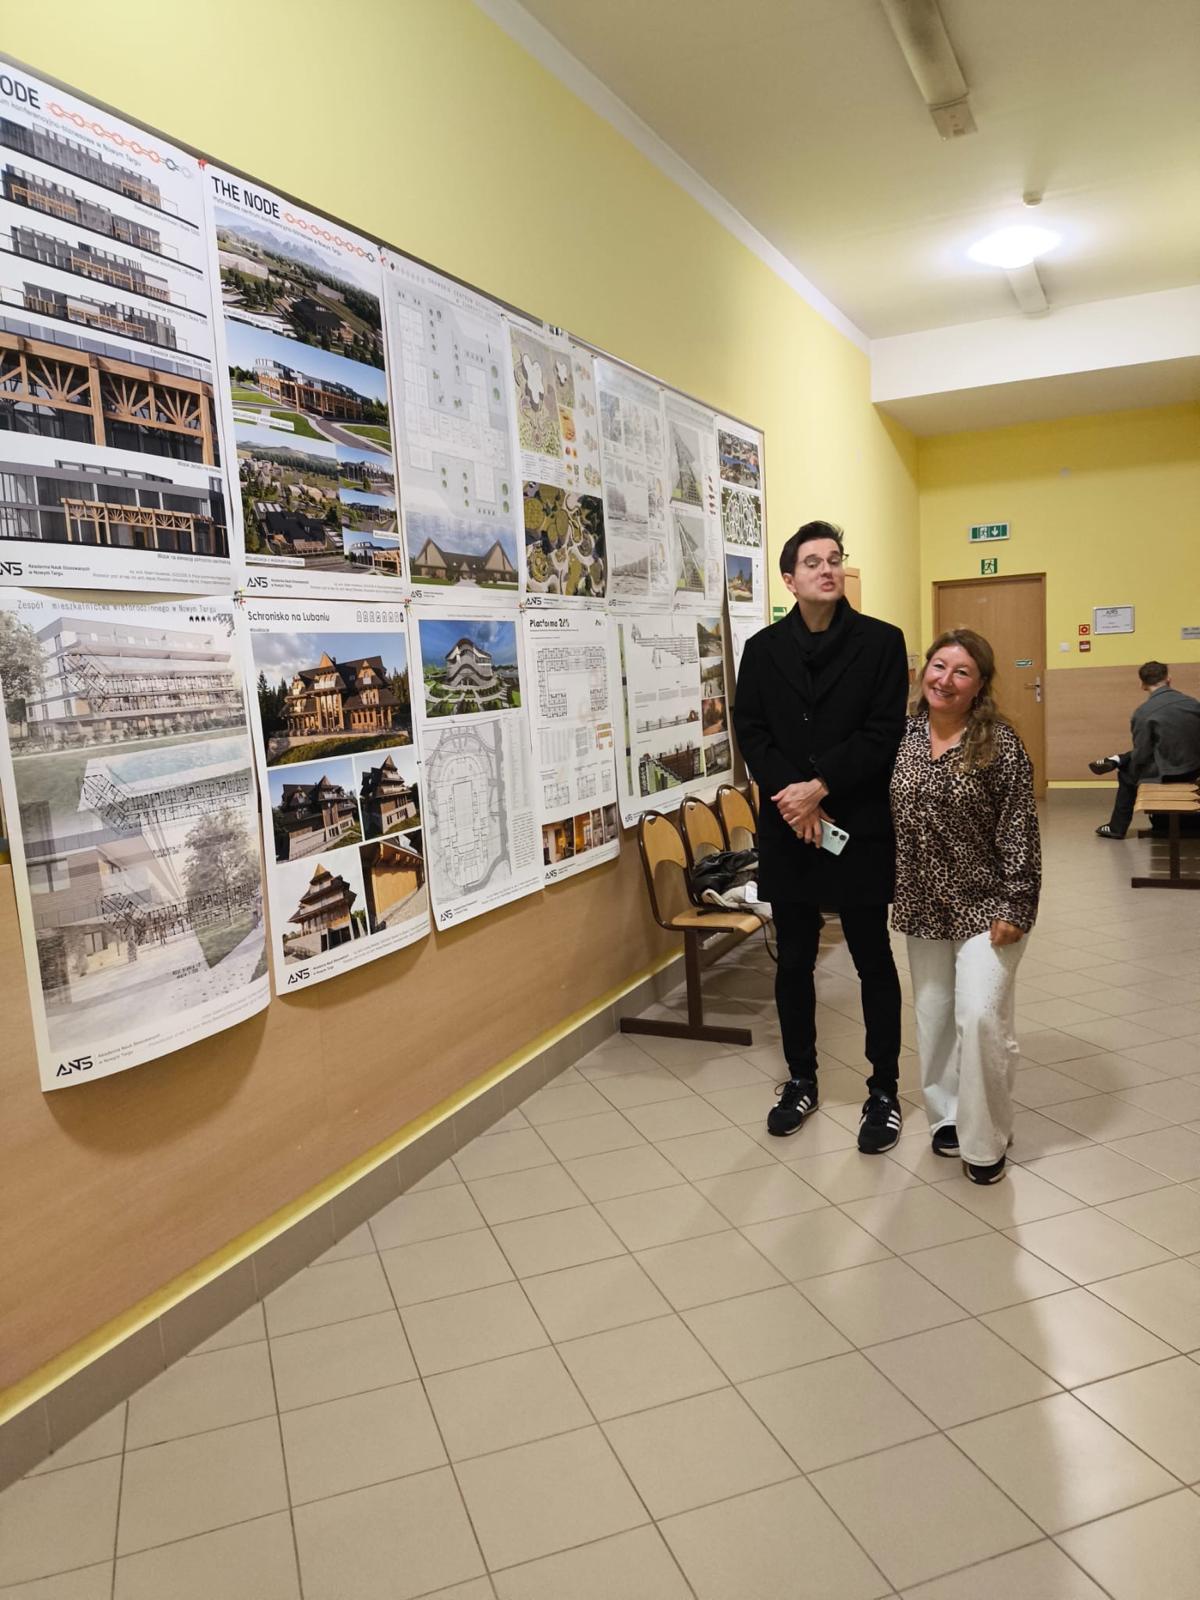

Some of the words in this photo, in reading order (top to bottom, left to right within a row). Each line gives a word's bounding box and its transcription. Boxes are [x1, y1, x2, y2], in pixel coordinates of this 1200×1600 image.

[211, 176, 240, 202] THE
[244, 190, 280, 219] NODE
[247, 611, 290, 621] Schronisko
[292, 613, 301, 621] na
[303, 612, 330, 621] Lubaniu
[529, 619, 558, 628] Platforma
[56, 1056, 93, 1077] ANS
